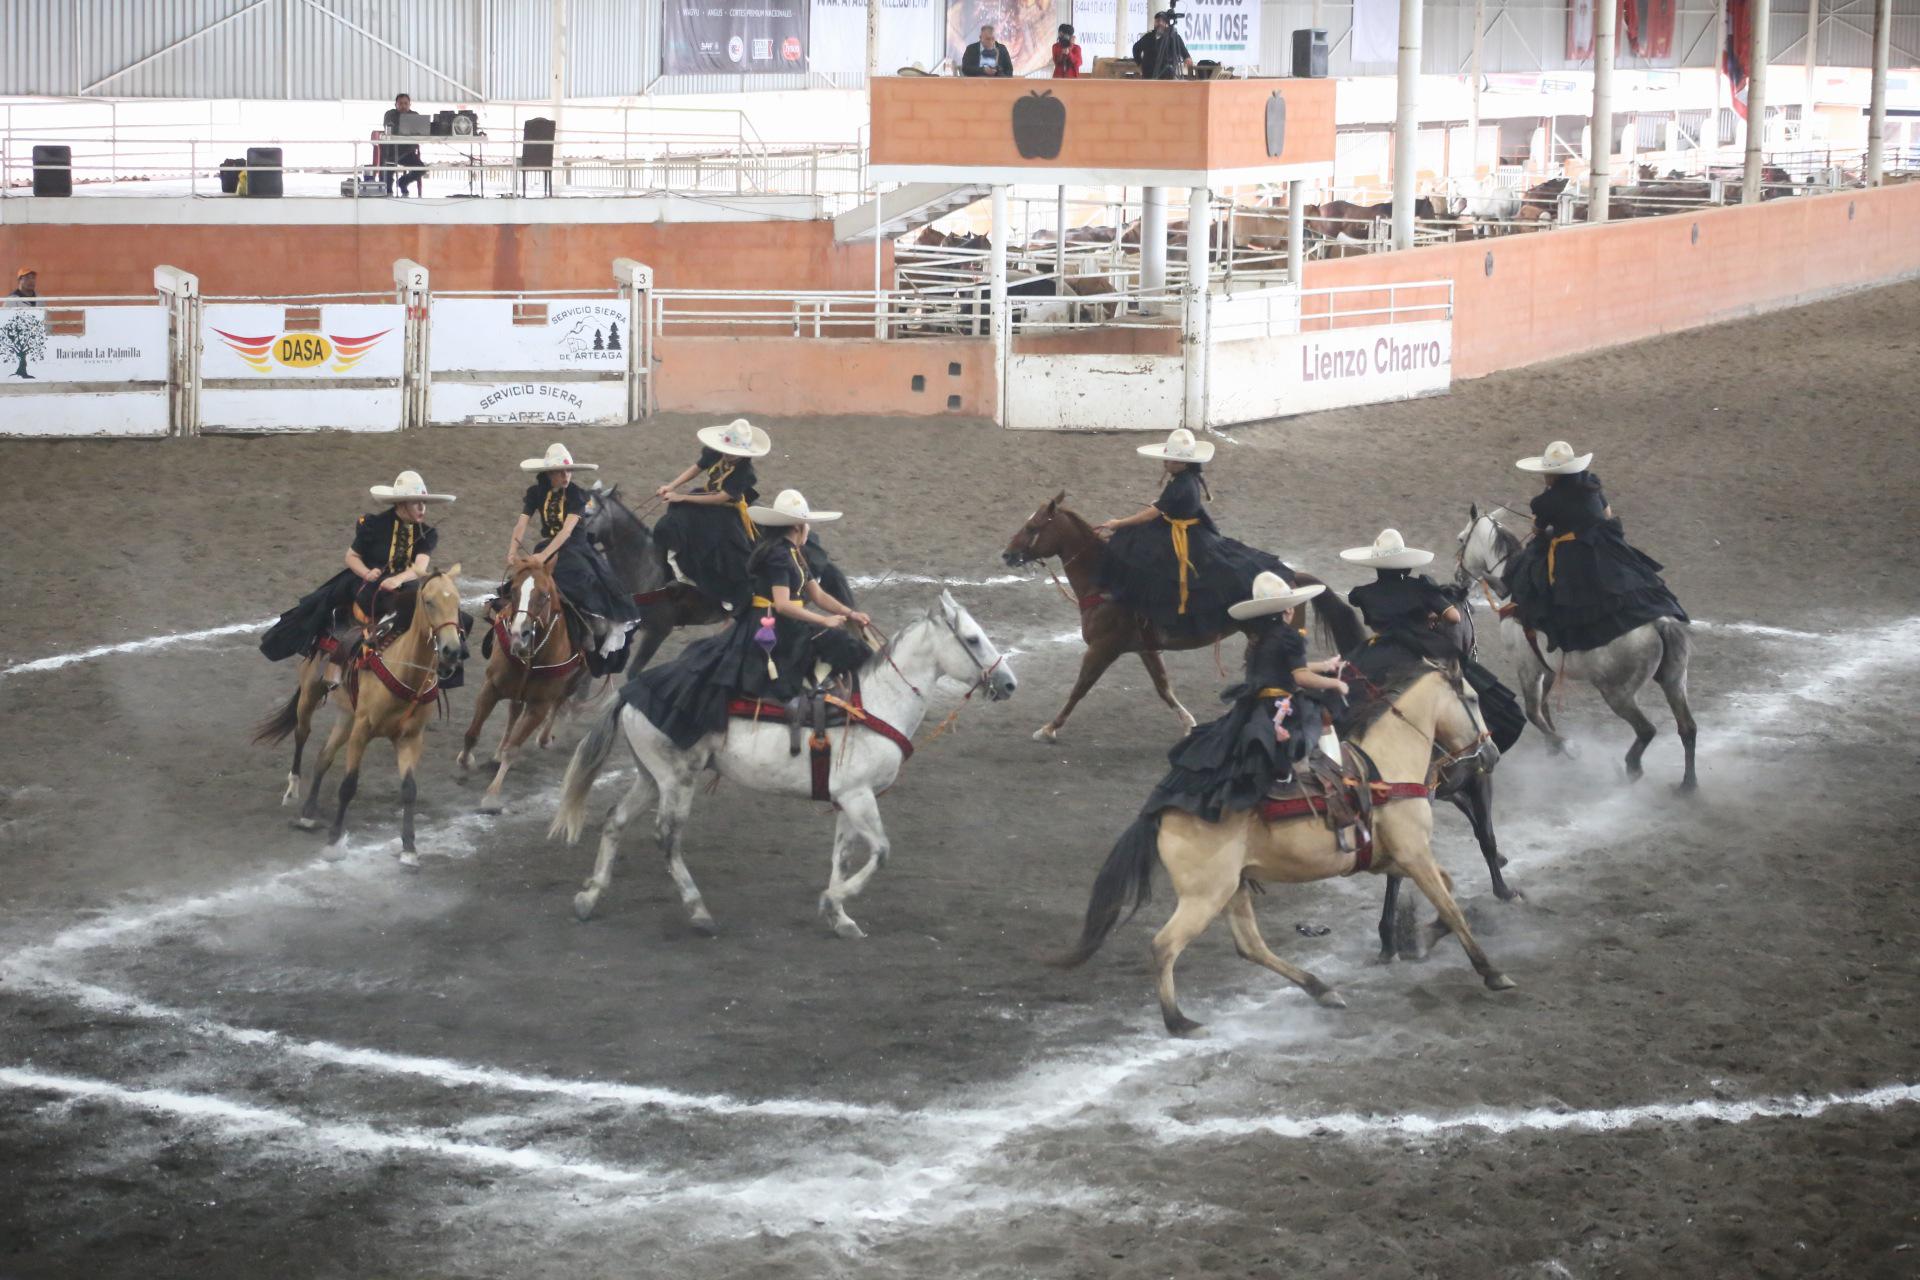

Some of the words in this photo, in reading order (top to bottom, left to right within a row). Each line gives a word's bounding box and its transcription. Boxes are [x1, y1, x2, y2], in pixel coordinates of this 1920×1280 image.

[1185, 13, 1211, 40] SAN
[1216, 13, 1248, 41] JOSE
[184, 282, 190, 291] 1
[415, 274, 422, 285] 2
[639, 274, 646, 284] 3
[551, 306, 591, 325] SERVICIO
[594, 306, 626, 323] SIERRA
[57, 348, 93, 359] Hacienda
[96, 348, 105, 358] La
[108, 347, 141, 358] Palmilla
[282, 339, 324, 362] DASA
[574, 352, 623, 360] ARTEAGA
[1302, 344, 1367, 382] Lienzo
[1374, 337, 1441, 374] Charro
[480, 385, 534, 410] SERVICIO
[539, 385, 583, 409] SIERRA
